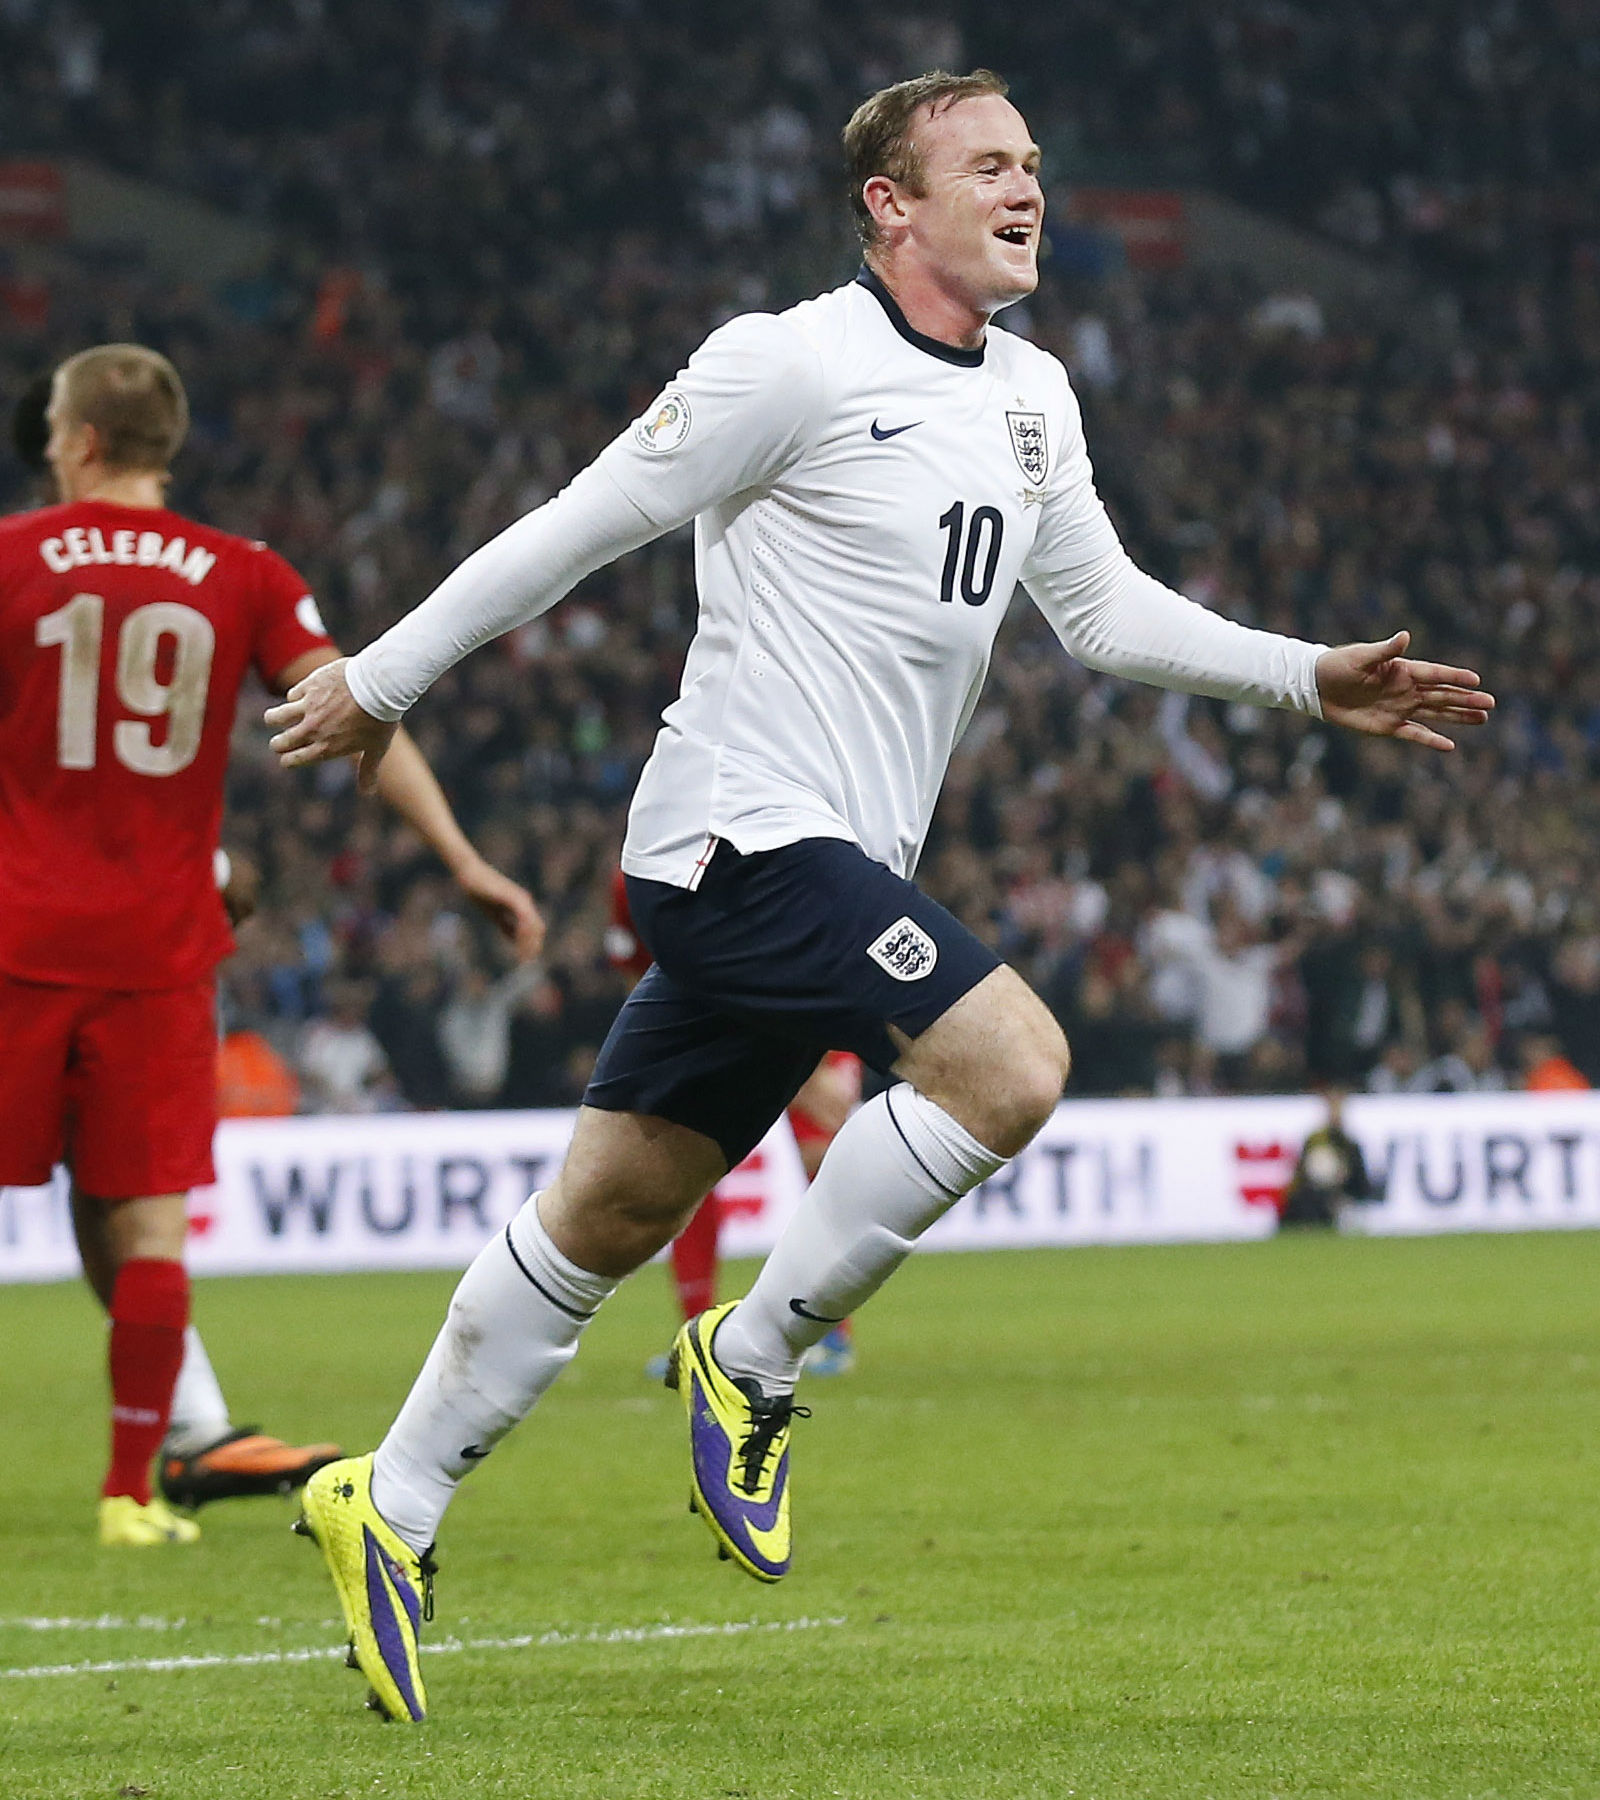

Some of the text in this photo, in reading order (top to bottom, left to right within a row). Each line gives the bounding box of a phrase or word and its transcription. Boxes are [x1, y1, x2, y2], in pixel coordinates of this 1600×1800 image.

[38, 526, 217, 586] CELEBAN
[938, 500, 1005, 607] 10
[35, 593, 216, 777] 19
